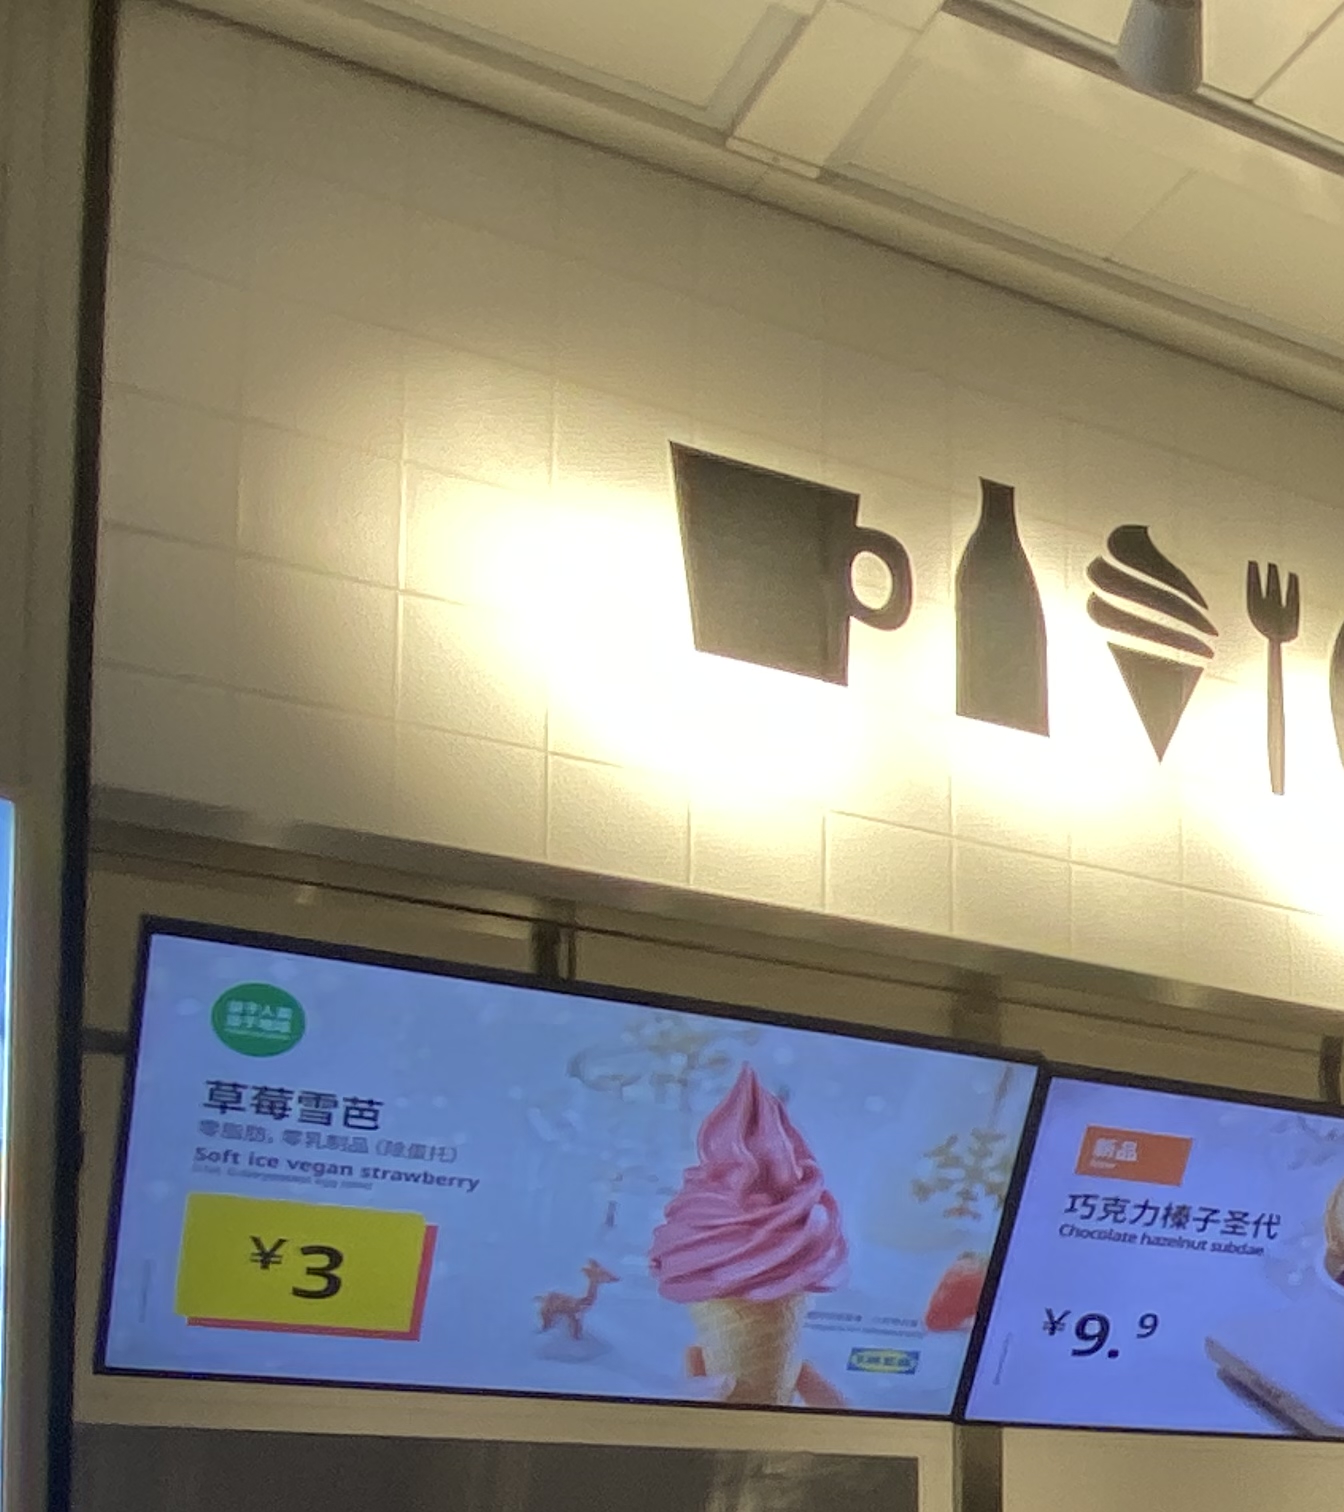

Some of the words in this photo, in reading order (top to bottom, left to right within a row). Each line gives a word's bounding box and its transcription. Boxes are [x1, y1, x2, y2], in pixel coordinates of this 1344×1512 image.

[204, 1079, 385, 1131] 草莓雪芭
[194, 1146, 240, 1167] Soft
[247, 1150, 280, 1169] ice
[286, 1156, 354, 1178] vegan
[360, 1164, 481, 1193] strawberry
[1058, 1222, 1138, 1245] Chocolate
[1139, 1229, 1208, 1252] hazelnut
[1063, 1192, 1282, 1241] 巧克力榛子圣代
